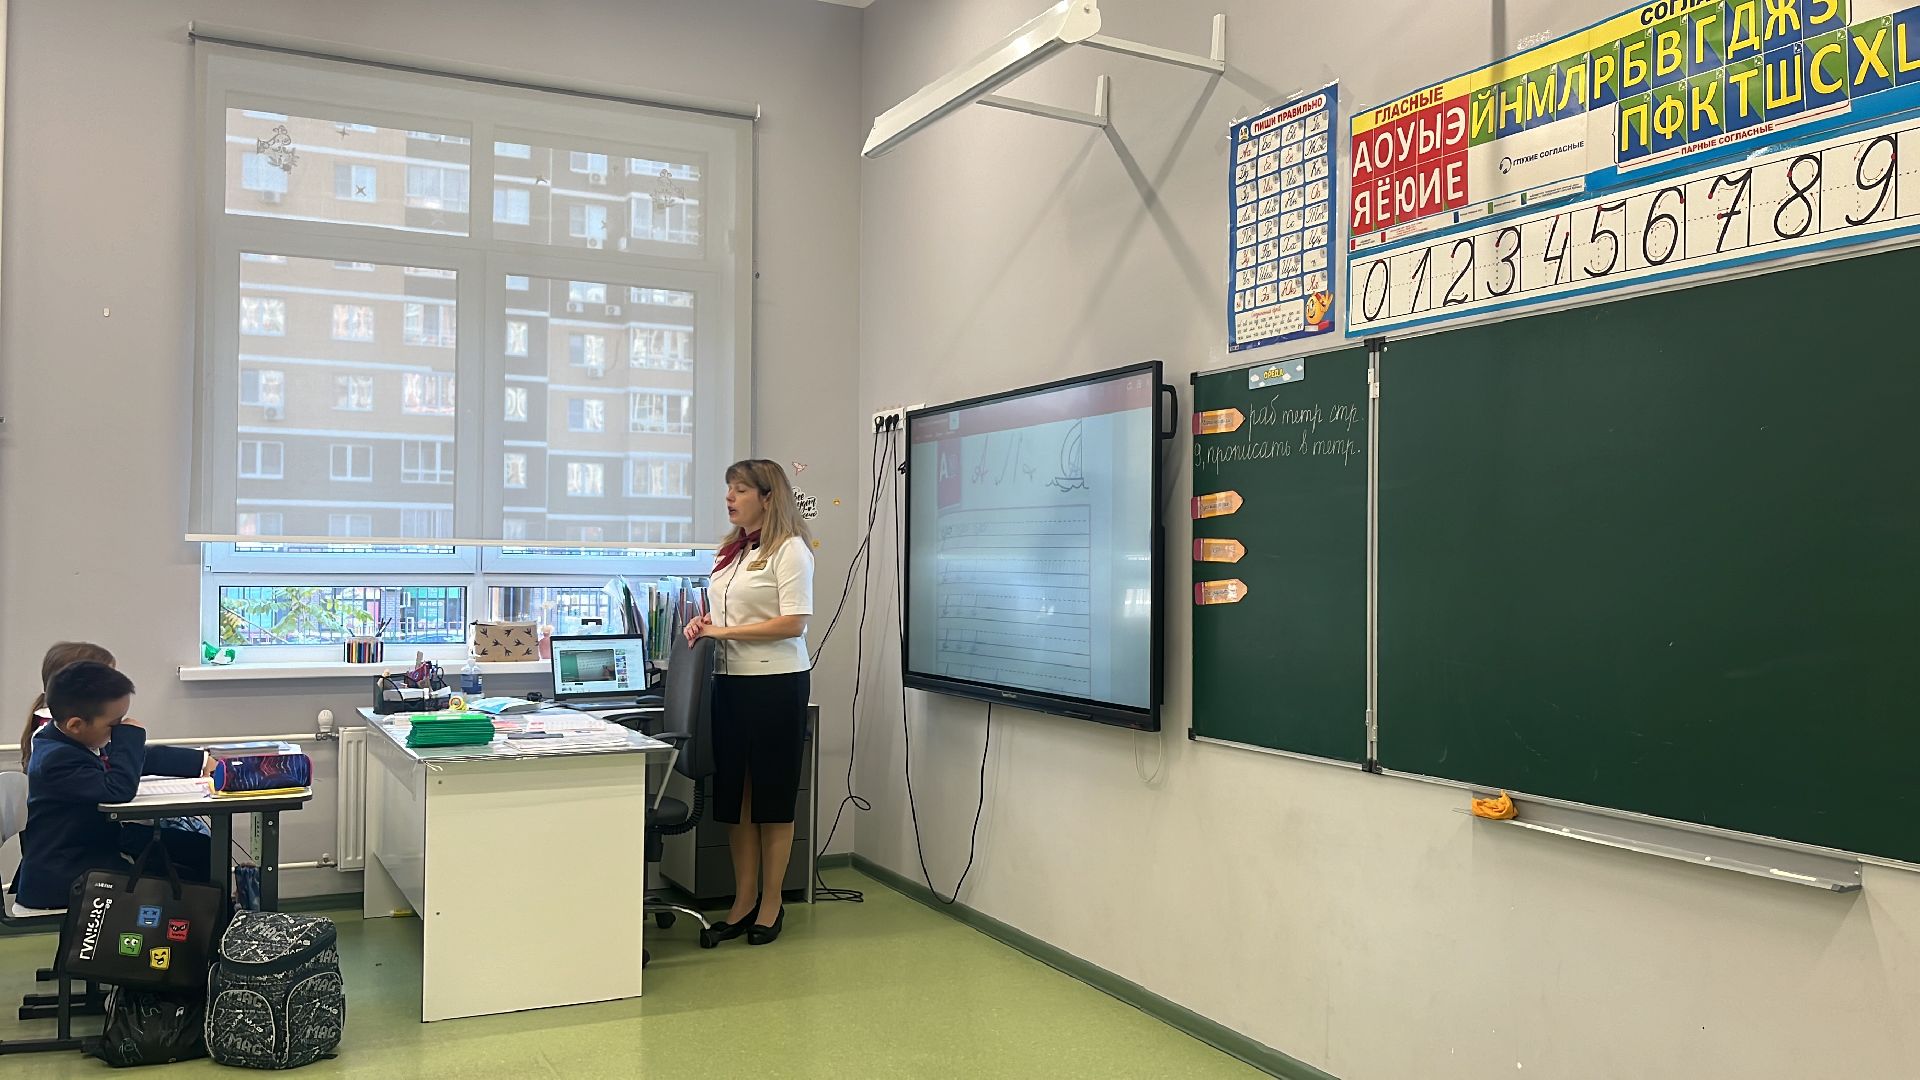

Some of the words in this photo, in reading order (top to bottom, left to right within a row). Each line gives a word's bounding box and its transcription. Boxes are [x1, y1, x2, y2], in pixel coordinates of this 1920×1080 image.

[1254, 117, 1276, 133] ПИШИ
[1277, 97, 1323, 122] ПРАВИЛЬНО
[1375, 86, 1444, 124] ГЛАСНЫЕ
[1540, 140, 1584, 159] СОГЛАСНЫЕ
[1681, 139, 1717, 155] ПАРНЫЕ
[1718, 124, 1774, 146] СОГЛАСНЫЕ
[1363, 258, 1389, 321] 0
[1411, 247, 1431, 313] 1
[1442, 238, 1475, 307] 2
[1486, 226, 1521, 296] 3
[1544, 214, 1569, 285] 4
[1583, 201, 1627, 277] 5
[1642, 186, 1685, 266] 6
[1708, 168, 1752, 253] 7
[1774, 154, 1821, 239] 8
[1845, 135, 1897, 226] 9
[1263, 368, 1284, 380] СРЕДА
[1248, 394, 1280, 441] раб
[1207, 440, 1291, 475] прописать
[1299, 430, 1309, 455] в
[1313, 438, 1361, 466] тетр.
